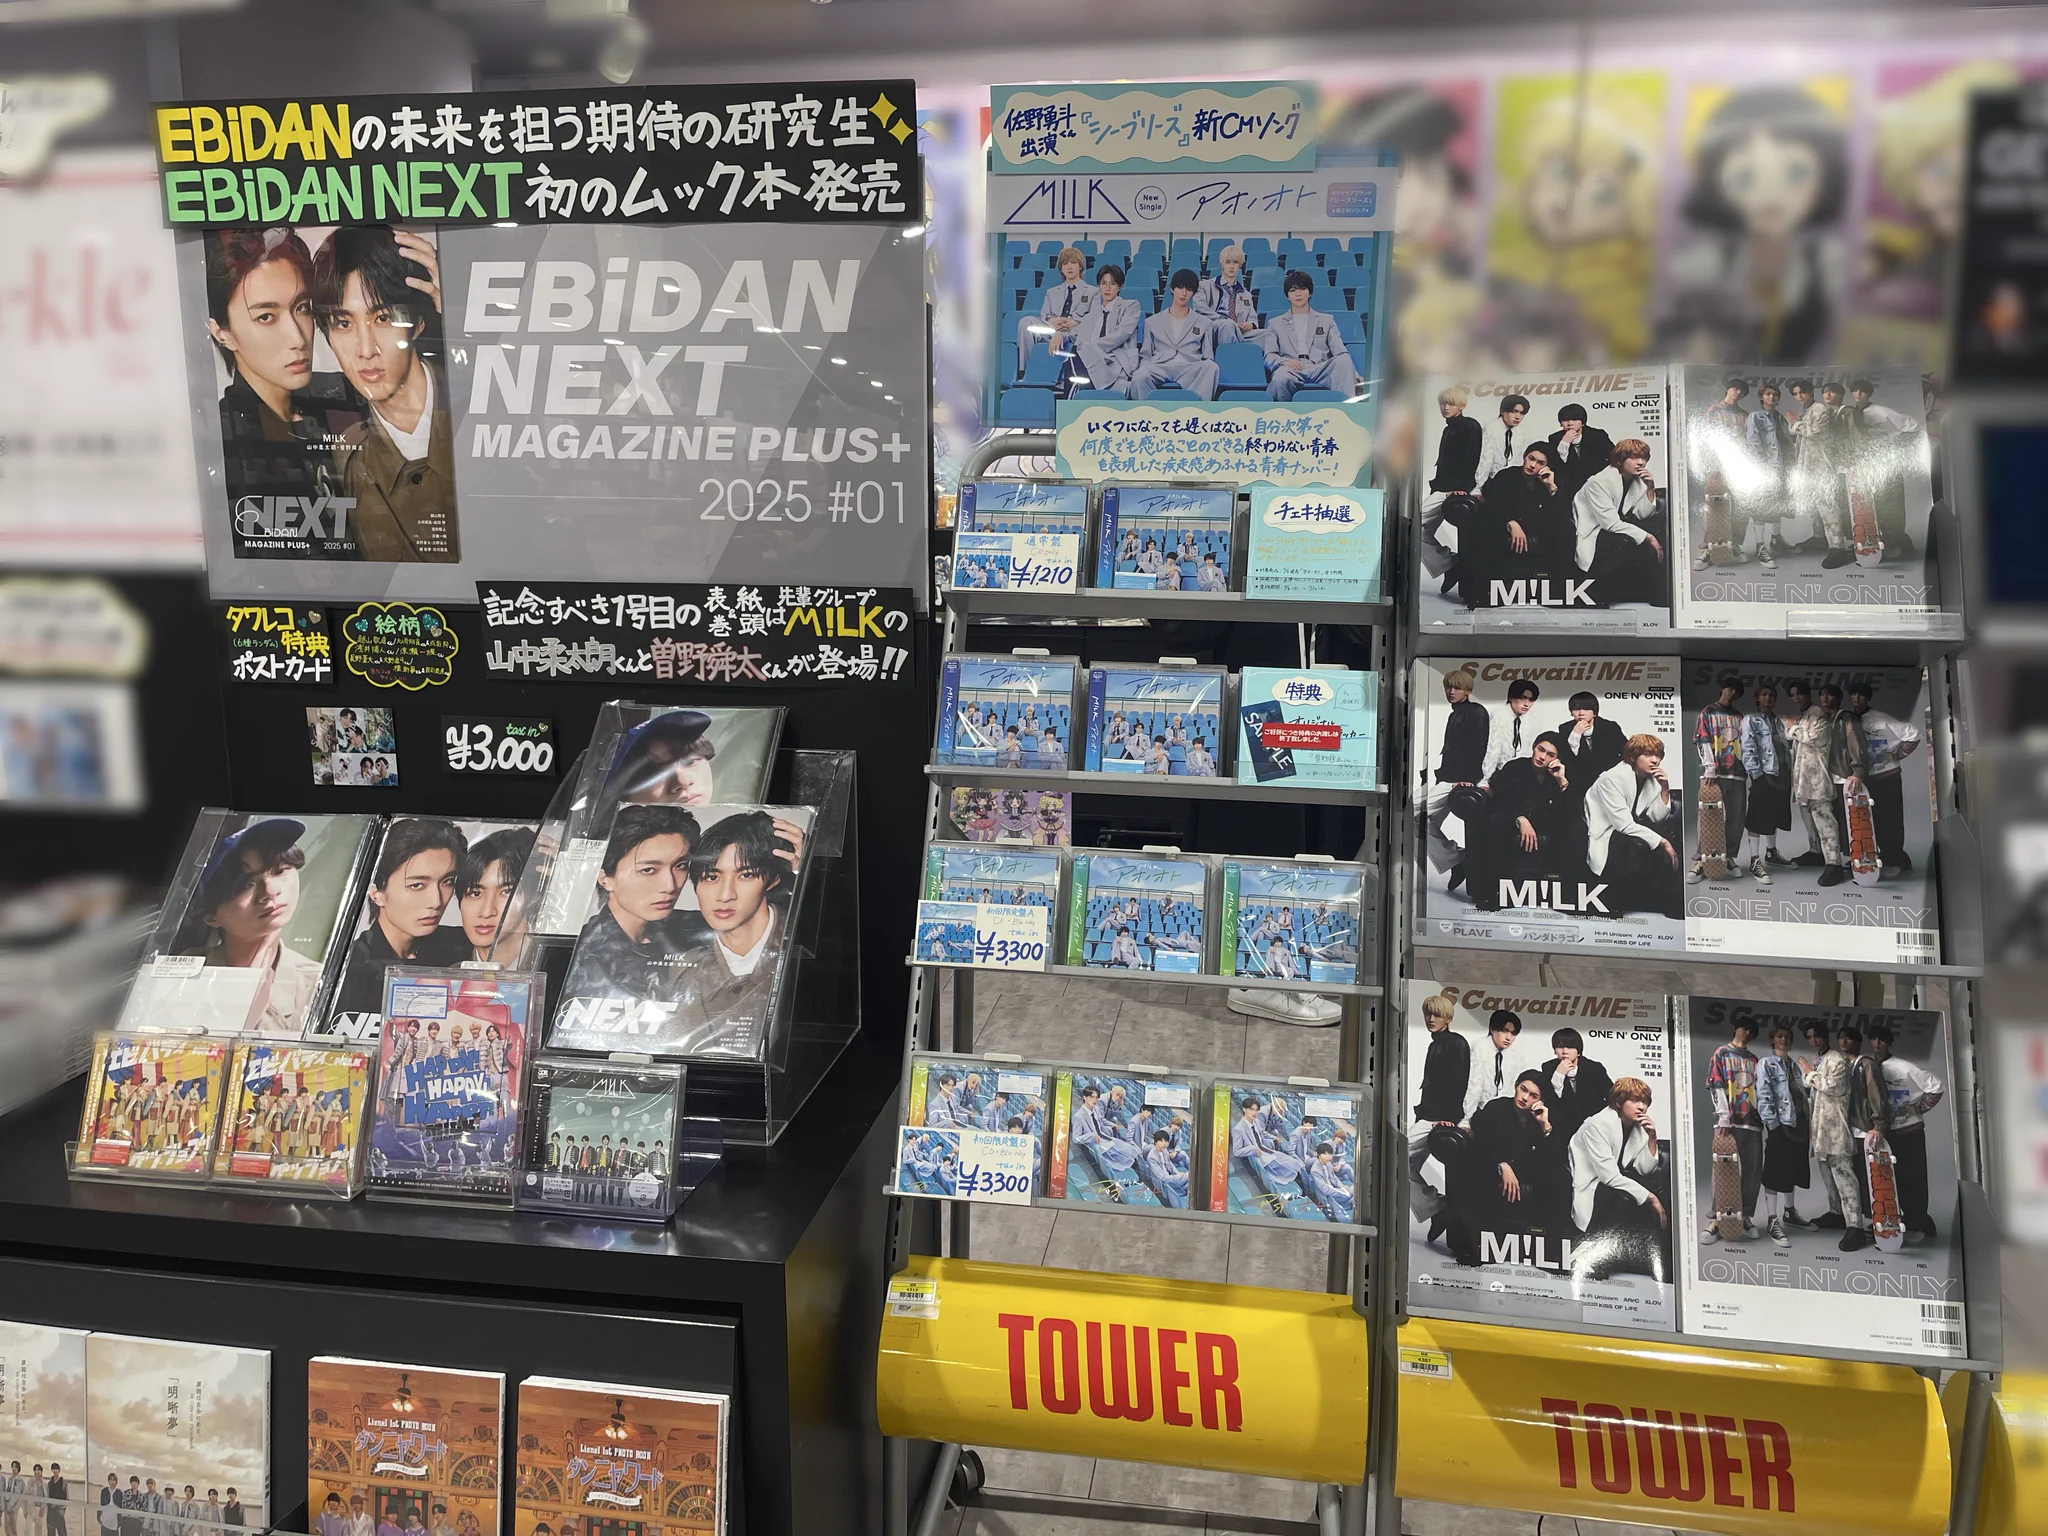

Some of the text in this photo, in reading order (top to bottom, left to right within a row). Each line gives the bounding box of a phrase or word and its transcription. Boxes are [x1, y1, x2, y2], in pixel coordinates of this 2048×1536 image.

[164, 157, 906, 223] EBiDAN NEXT 初のムック本発売
[1143, 194, 1159, 202] New
[1139, 203, 1162, 212] Single
[463, 258, 861, 334] EBiDAN
[469, 344, 749, 417] NEXT
[1585, 372, 1633, 393] ME
[1592, 401, 1616, 410] ONE
[1632, 399, 1660, 408] ONLY
[471, 425, 910, 464] MAGAZINE PLUS+
[700, 479, 905, 525] 2025 #01
[1273, 501, 1355, 523] チェキ抽選
[244, 540, 285, 549] MAGAZINE
[323, 541, 342, 550] 2025
[1489, 578, 1597, 606] M!LK
[1694, 581, 1778, 604] ONE
[1827, 584, 1933, 606] ONLY
[225, 606, 295, 633] タワレコ
[374, 614, 421, 637] 絵柄
[280, 630, 331, 658] 特典
[232, 651, 332, 683] ポストカード
[1481, 661, 1596, 682] Cawaii!
[1596, 661, 1647, 682] ME
[1285, 682, 1322, 701] 特典
[1604, 692, 1628, 700] ONE
[1644, 692, 1675, 701] ONLY
[446, 723, 553, 772] ¥3,000
[1499, 878, 1611, 914] M!LK
[1687, 896, 1772, 921] ONE
[1823, 903, 1932, 929] ONLY
[1453, 927, 1493, 938] PLAVE
[1595, 930, 1609, 938] Hi-Fi
[1609, 931, 1633, 939] Unicorn
[1462, 989, 1578, 1016] Cawaii!
[1581, 996, 1633, 1019] ME
[1633, 1003, 1657, 1011] SUMMER
[1588, 1029, 1614, 1039] ONE
[1630, 1032, 1662, 1042] ONLY
[1702, 1258, 1791, 1289] ONE
[1844, 1271, 1957, 1301] ONLY
[1594, 1294, 1619, 1302] Unicorn
[999, 1312, 1243, 1433] TOWER
[401, 1420, 420, 1430] PHOTO
[614, 1449, 634, 1459] PHOTO
[1540, 1396, 1795, 1513] TOWER
